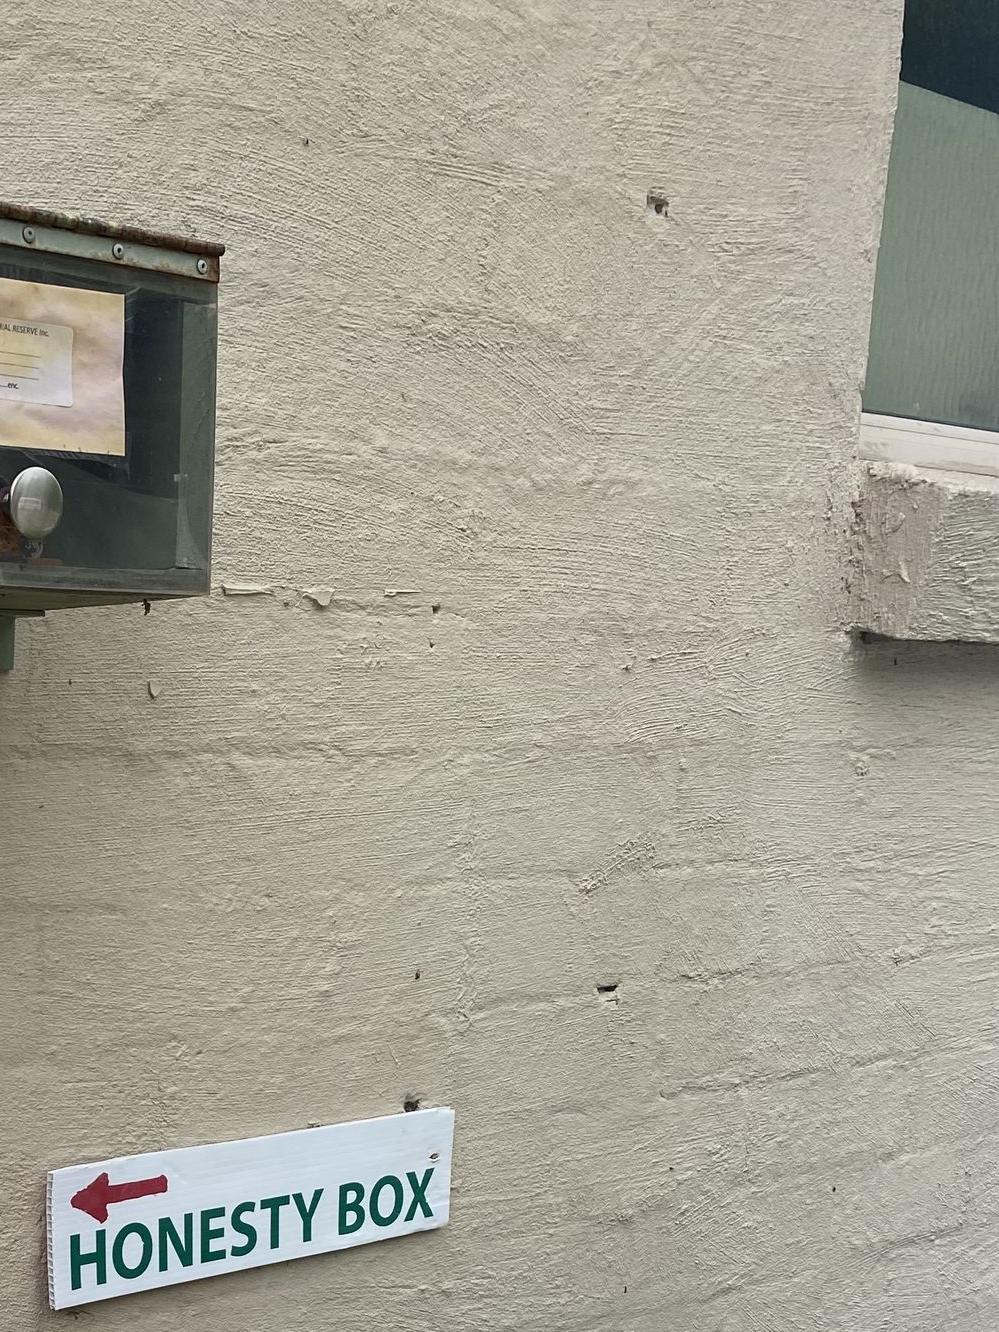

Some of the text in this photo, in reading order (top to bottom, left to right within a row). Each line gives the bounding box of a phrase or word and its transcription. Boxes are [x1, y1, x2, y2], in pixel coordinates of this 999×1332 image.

[13, 324, 38, 336] RESERVE
[39, 329, 49, 337] Inc.
[69, 1167, 435, 1290] HONESTY BOX
